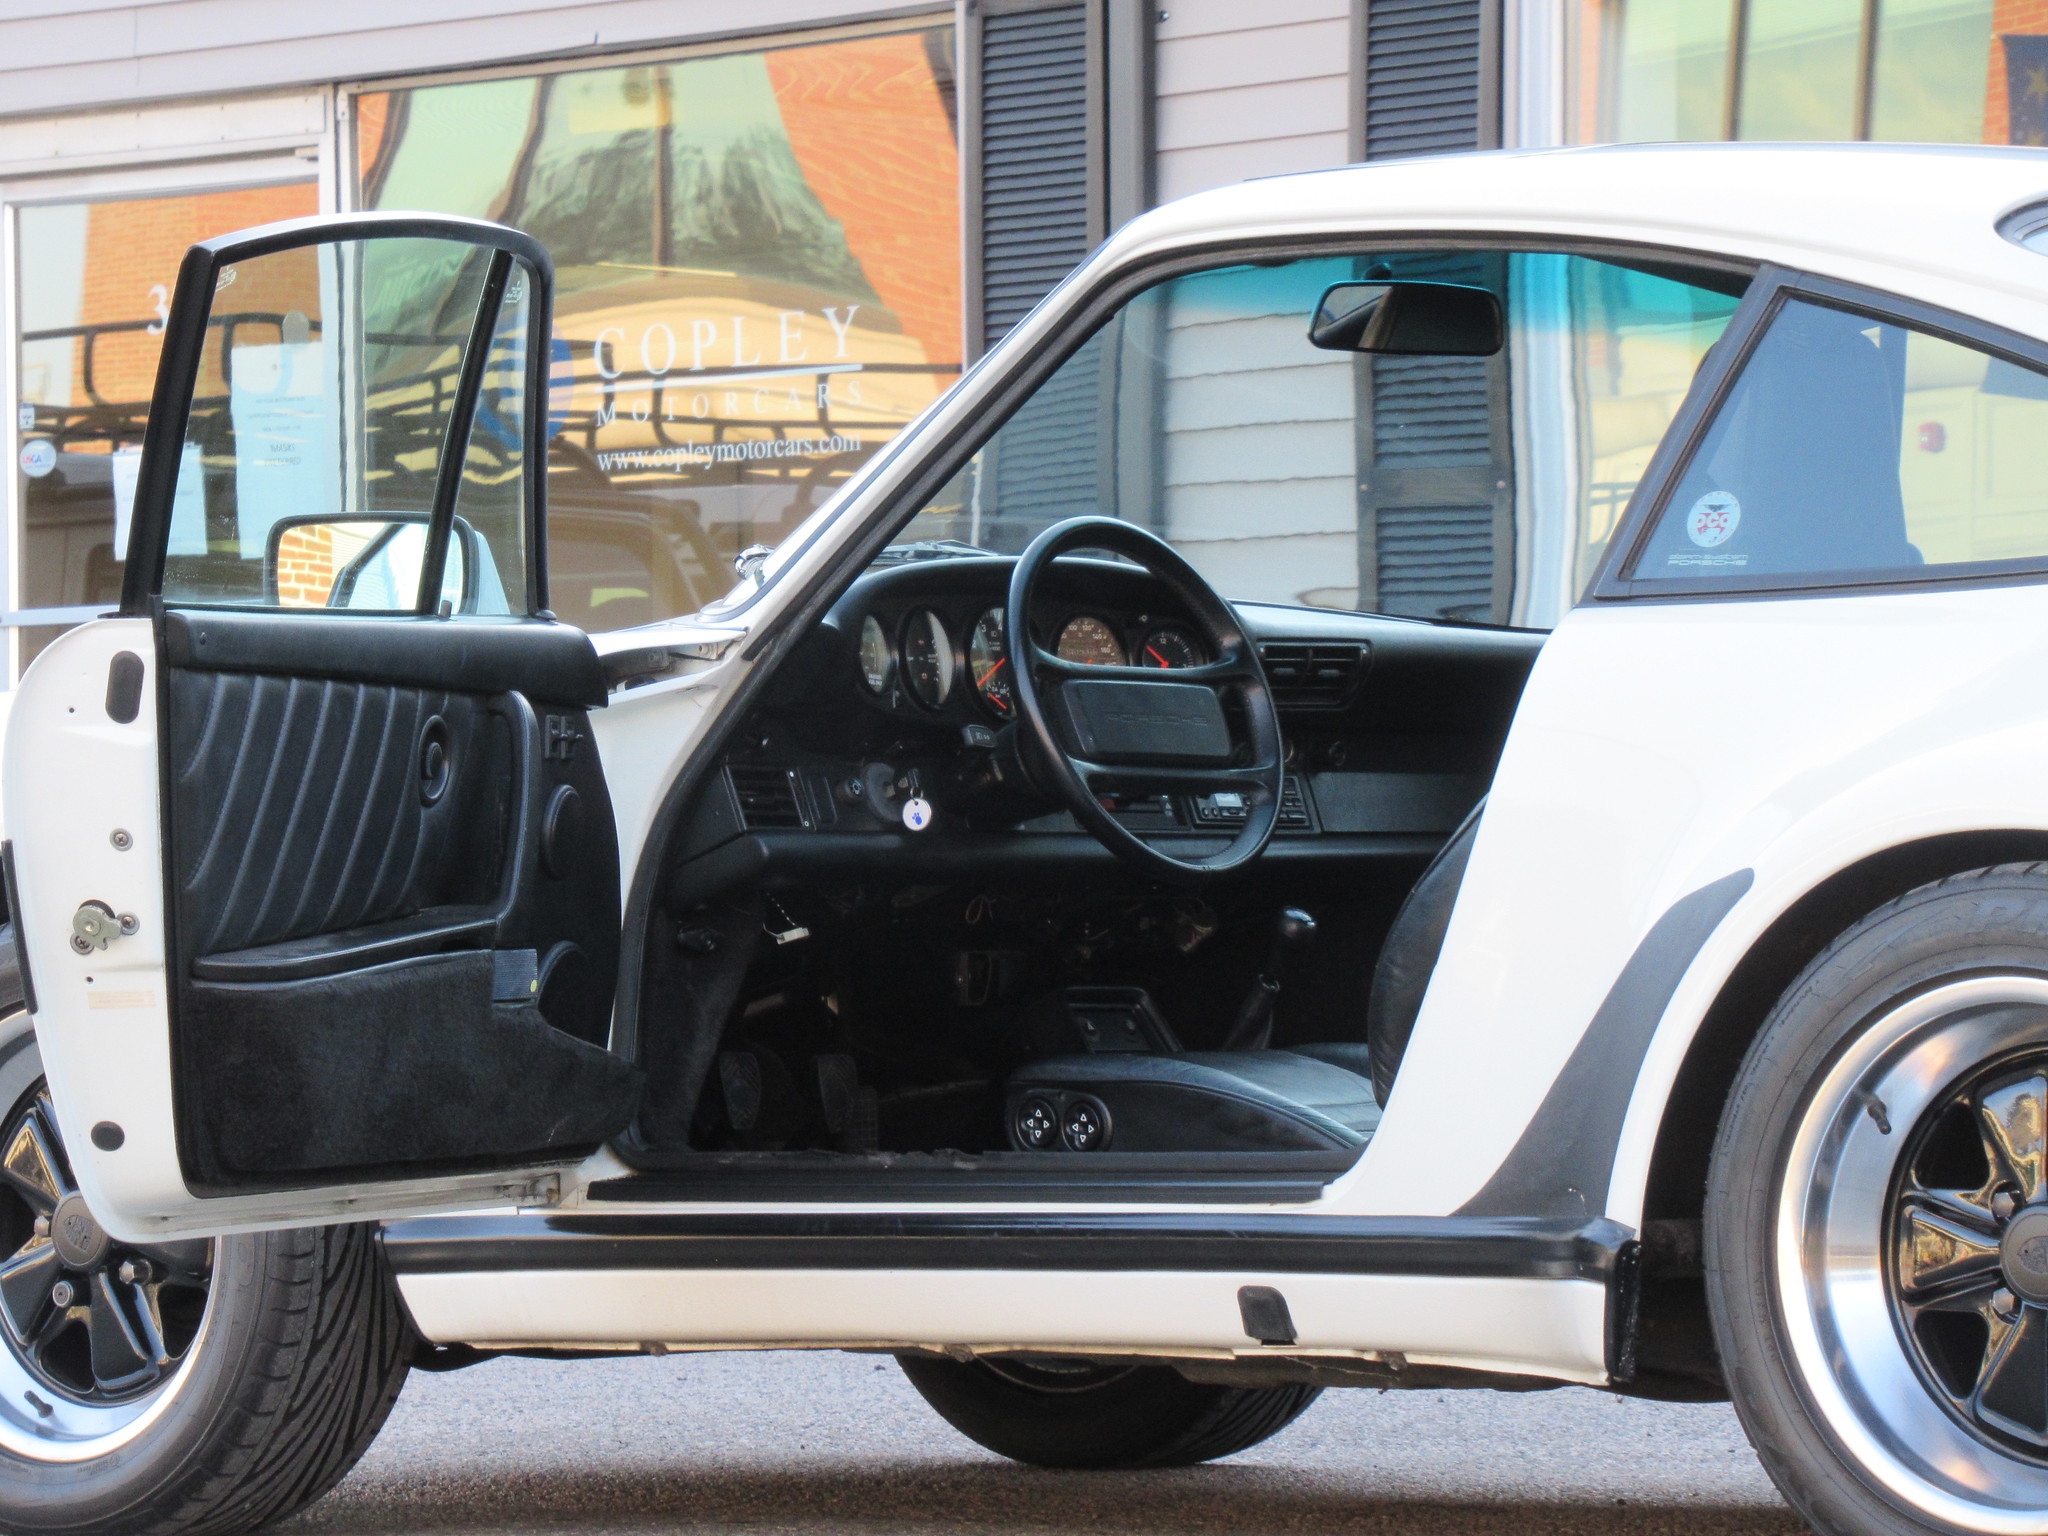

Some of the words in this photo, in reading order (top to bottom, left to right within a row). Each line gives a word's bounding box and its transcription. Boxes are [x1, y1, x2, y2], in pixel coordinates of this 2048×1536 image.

[594, 305, 860, 379] COPLEY
[596, 381, 862, 427] MOTORCARS
[597, 433, 861, 472] www.copleymotorcars.com
